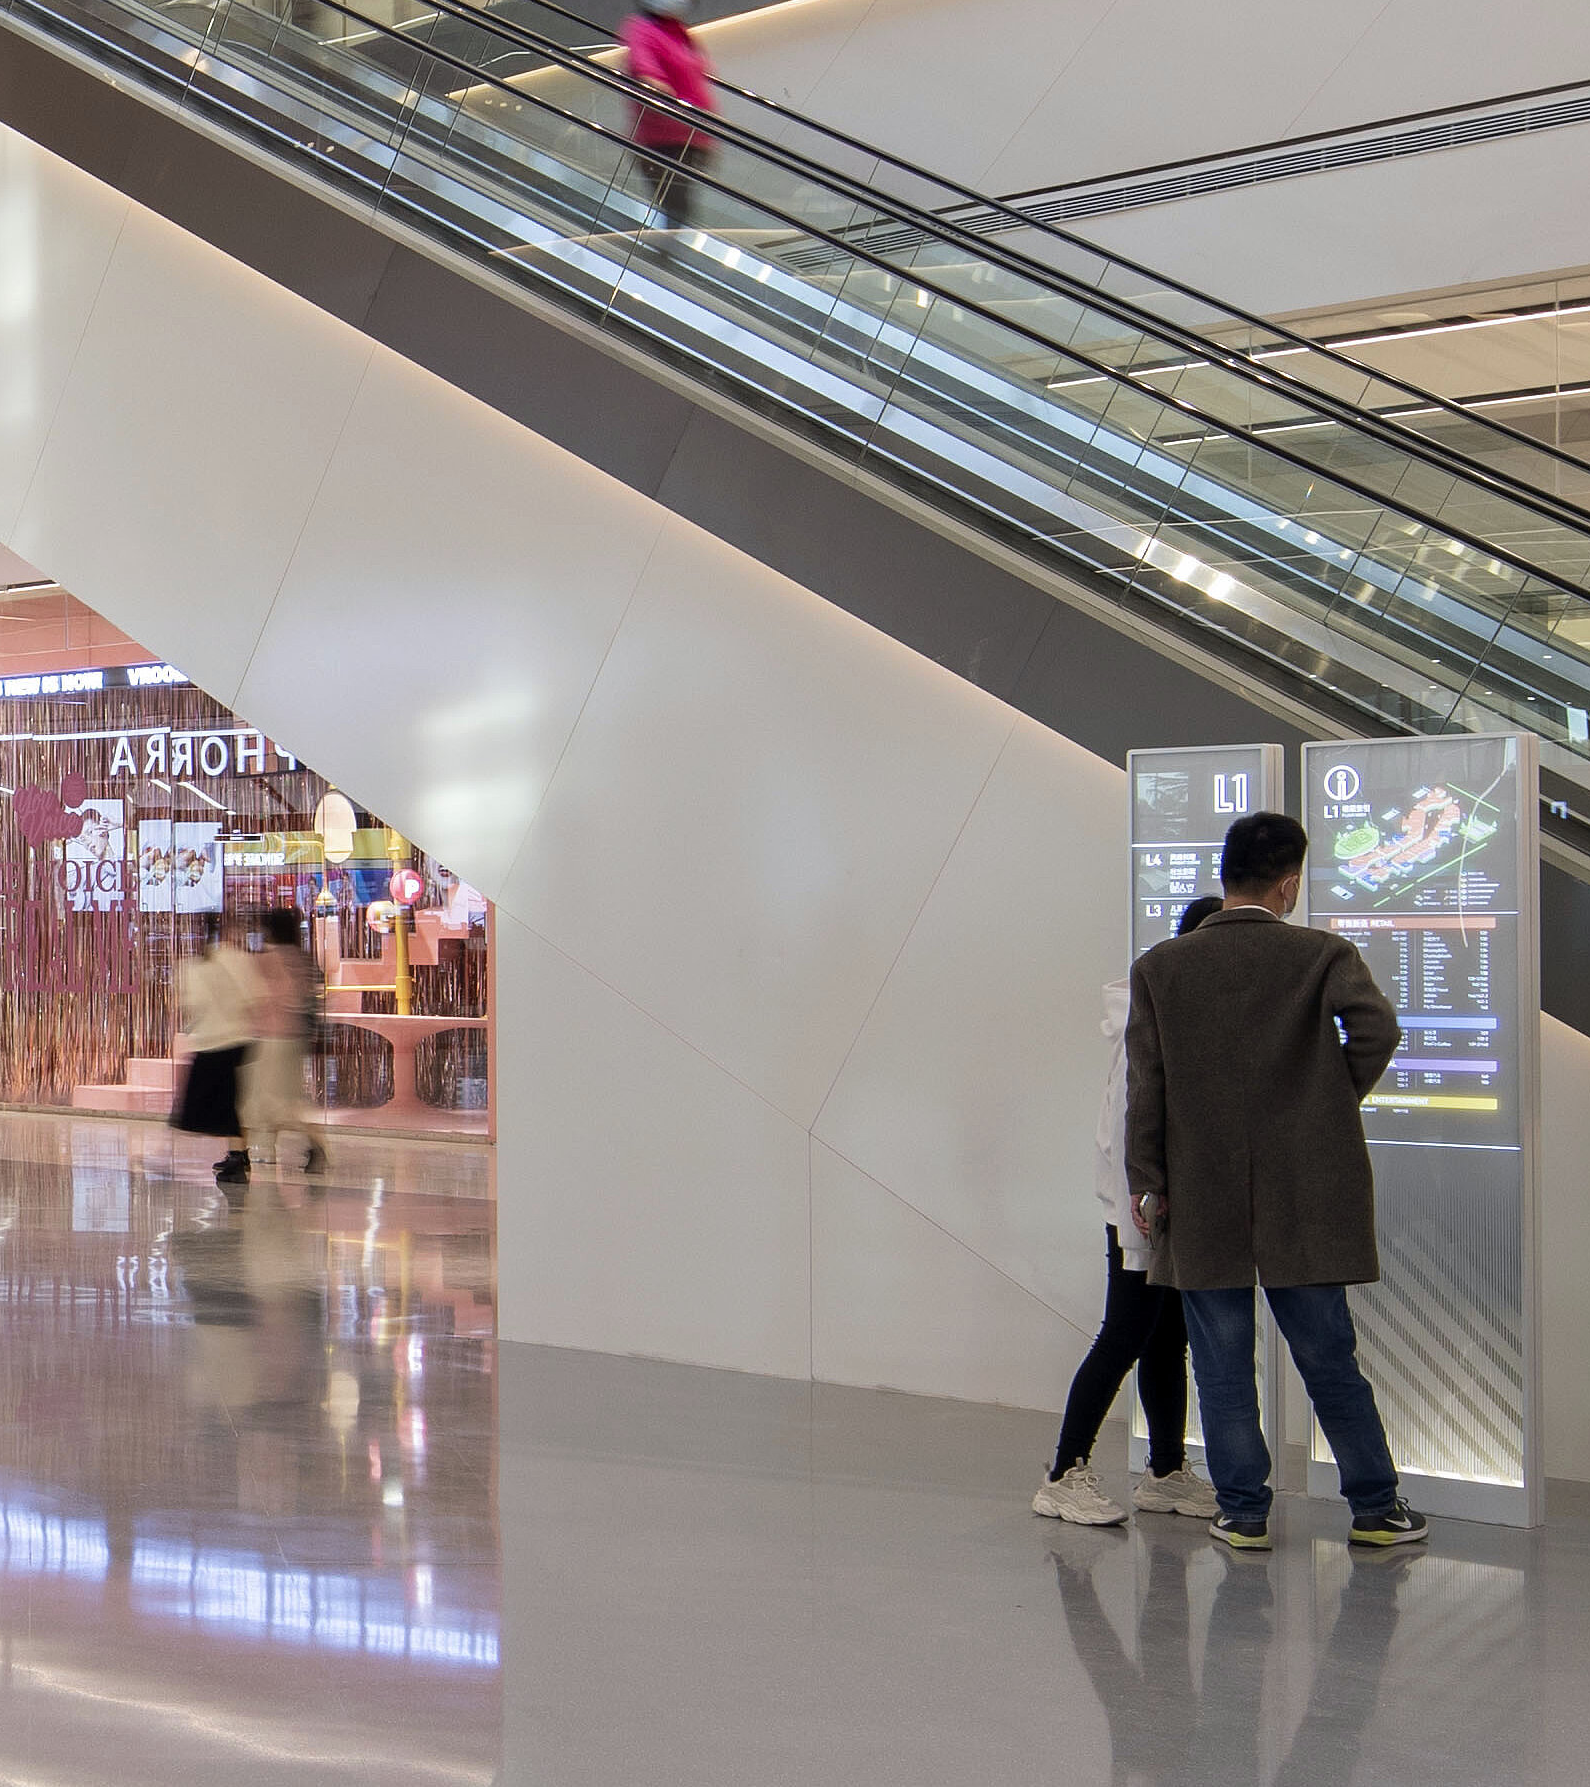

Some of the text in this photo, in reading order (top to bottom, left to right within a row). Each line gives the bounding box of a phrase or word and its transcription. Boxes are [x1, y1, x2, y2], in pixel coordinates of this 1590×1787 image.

[3, 676, 39, 697] NEW
[1213, 772, 1250, 814] L1
[1323, 805, 1340, 819] L1
[1145, 853, 1163, 867] L4
[32, 859, 138, 893] VOICE
[1145, 903, 1163, 917] L3
